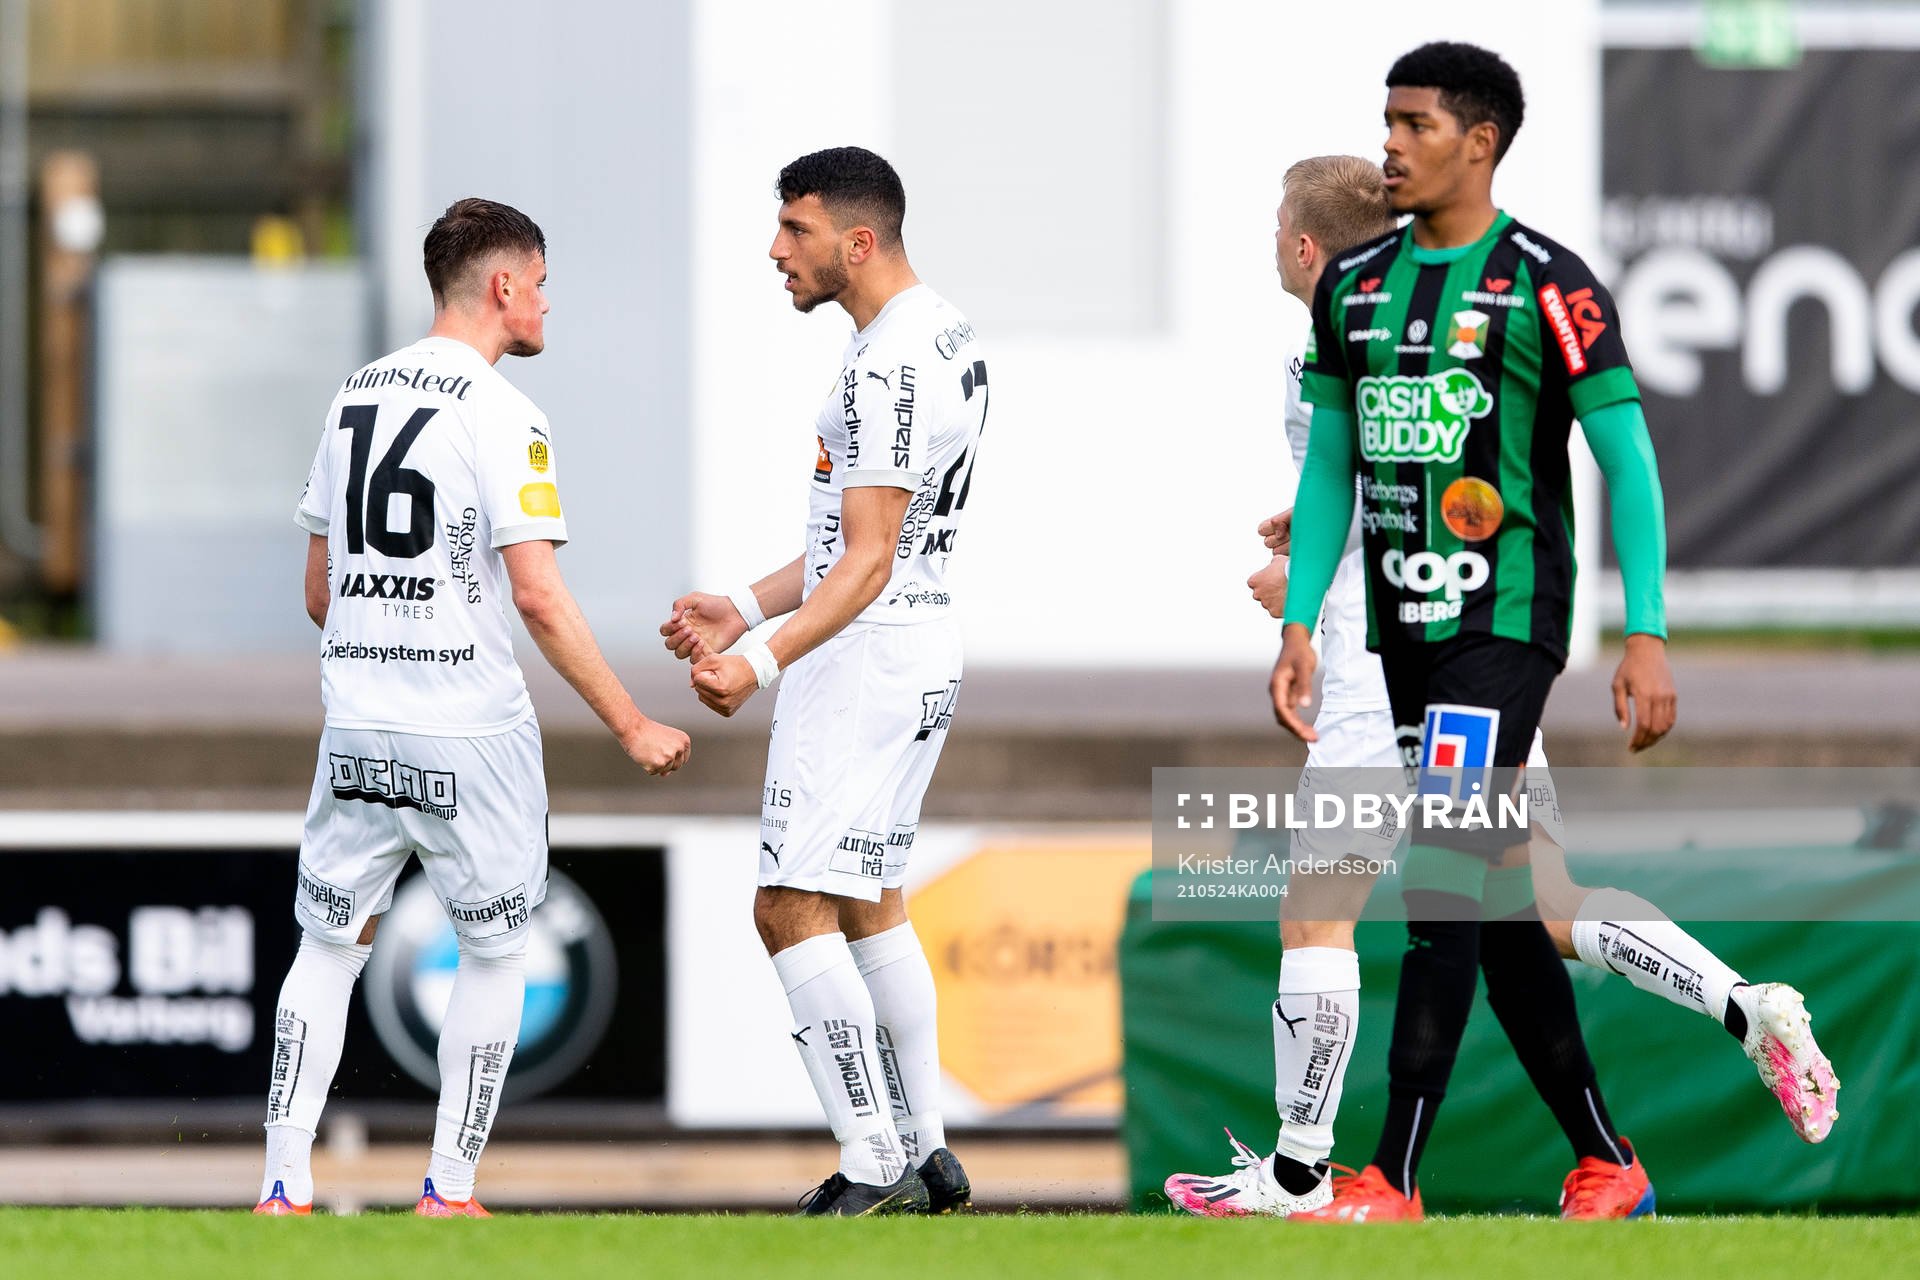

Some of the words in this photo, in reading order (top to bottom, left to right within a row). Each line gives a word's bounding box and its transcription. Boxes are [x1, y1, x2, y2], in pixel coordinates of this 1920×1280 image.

[1542, 287, 1584, 375] KVANTUM
[1565, 287, 1607, 350] ICA
[890, 364, 916, 470] stadium
[1359, 384, 1431, 420] CASH
[1364, 419, 1462, 454] BUDDY
[338, 404, 440, 560] 16
[382, 603, 434, 620] TYRES
[438, 644, 475, 666] syd
[423, 804, 458, 821] GROUP
[861, 854, 882, 877] trä
[326, 905, 349, 926] trä
[449, 891, 526, 923] kungälvs
[504, 906, 528, 930] trä
